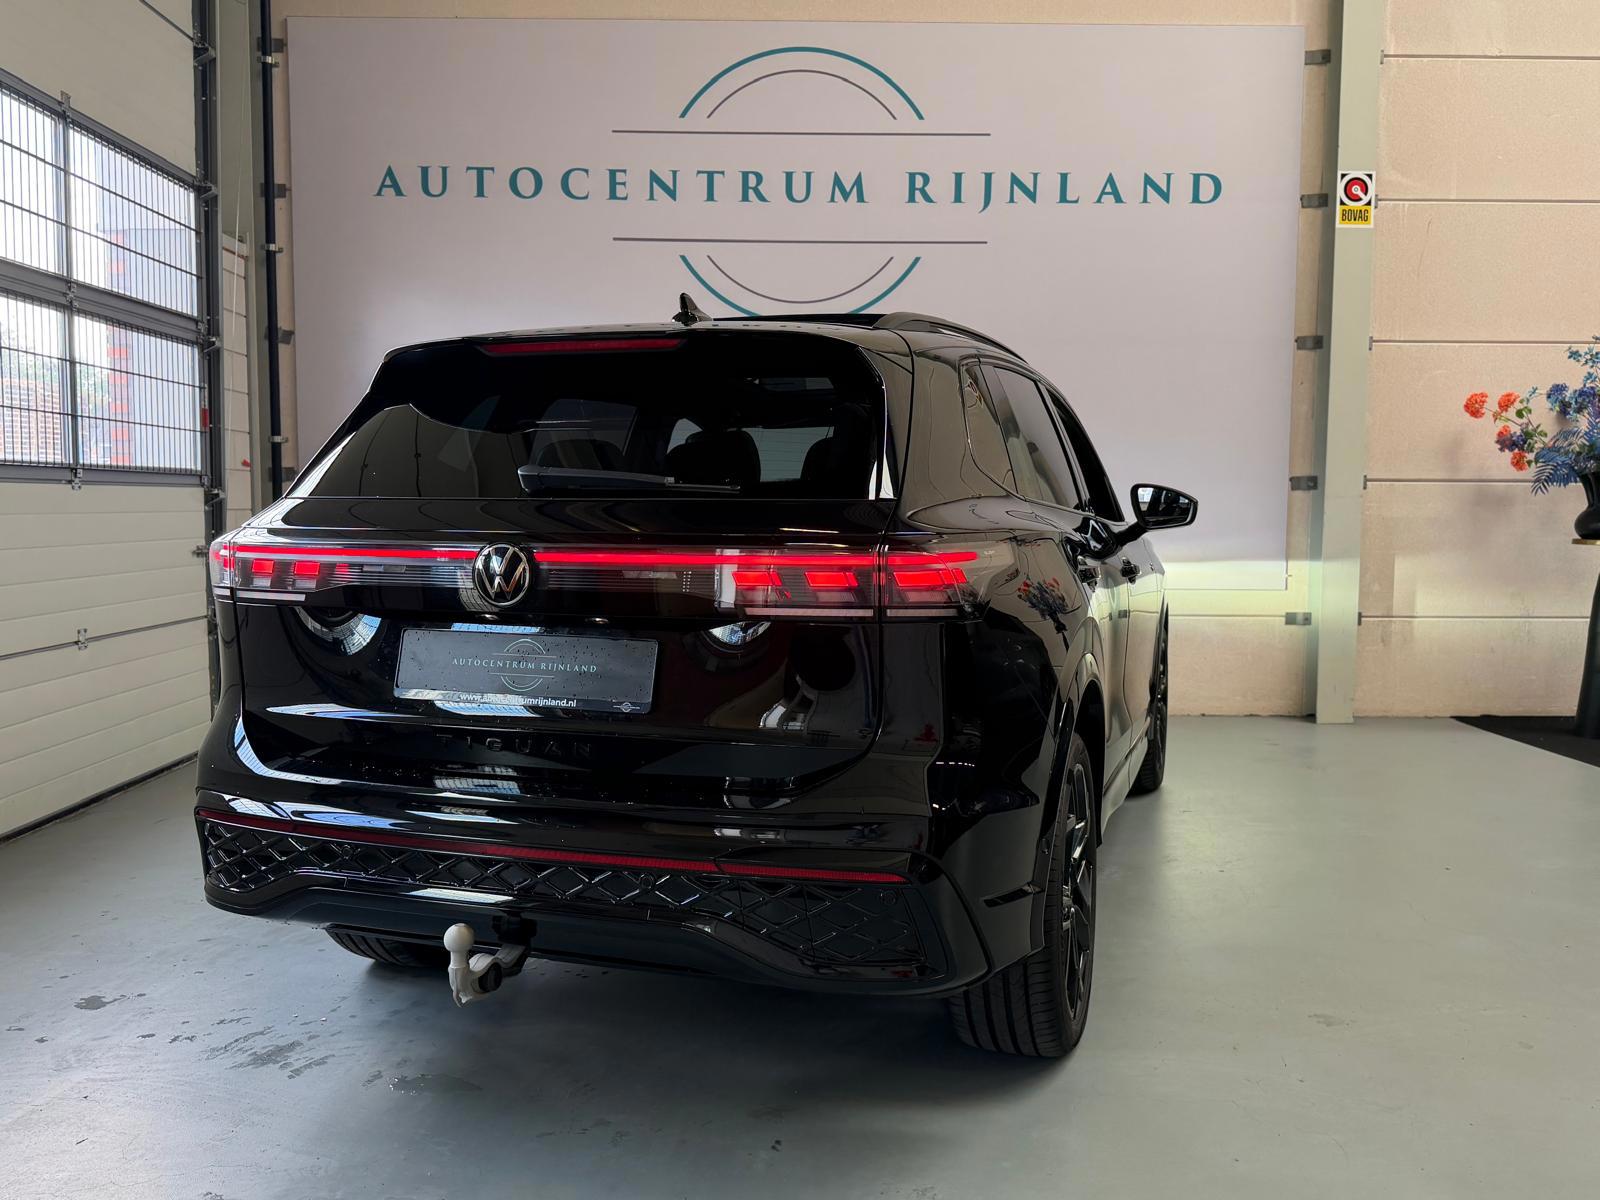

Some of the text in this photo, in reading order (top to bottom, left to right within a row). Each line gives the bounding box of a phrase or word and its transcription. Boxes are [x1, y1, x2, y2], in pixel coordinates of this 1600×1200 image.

[372, 164, 1223, 214] AUTOCENTRUM RIJNLAND
[1341, 208, 1369, 222] BOVAG
[452, 658, 598, 673] AUTOCENTRUM RIJNLAND
[459, 692, 577, 708] www.aumrijnland.nl
[436, 733, 593, 758] TIGUAN
